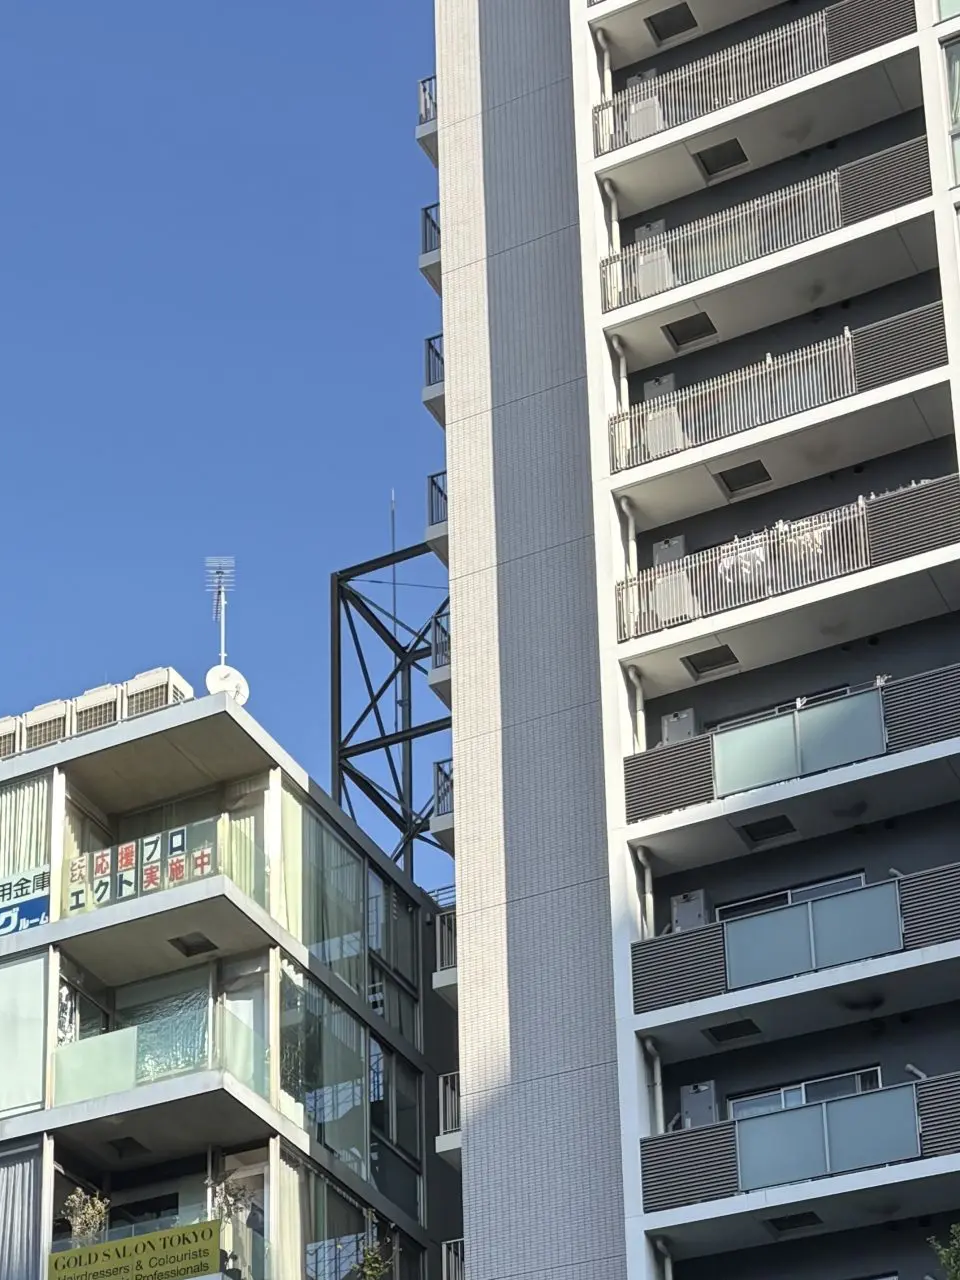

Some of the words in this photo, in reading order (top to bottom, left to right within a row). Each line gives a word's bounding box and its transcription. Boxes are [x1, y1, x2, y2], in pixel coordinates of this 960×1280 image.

[54, 1252, 99, 1271] GOLD
[101, 1239, 156, 1263] SALON
[159, 1227, 214, 1250] TOKYO
[135, 1259, 144, 1271] &
[148, 1248, 210, 1269] Colourists
